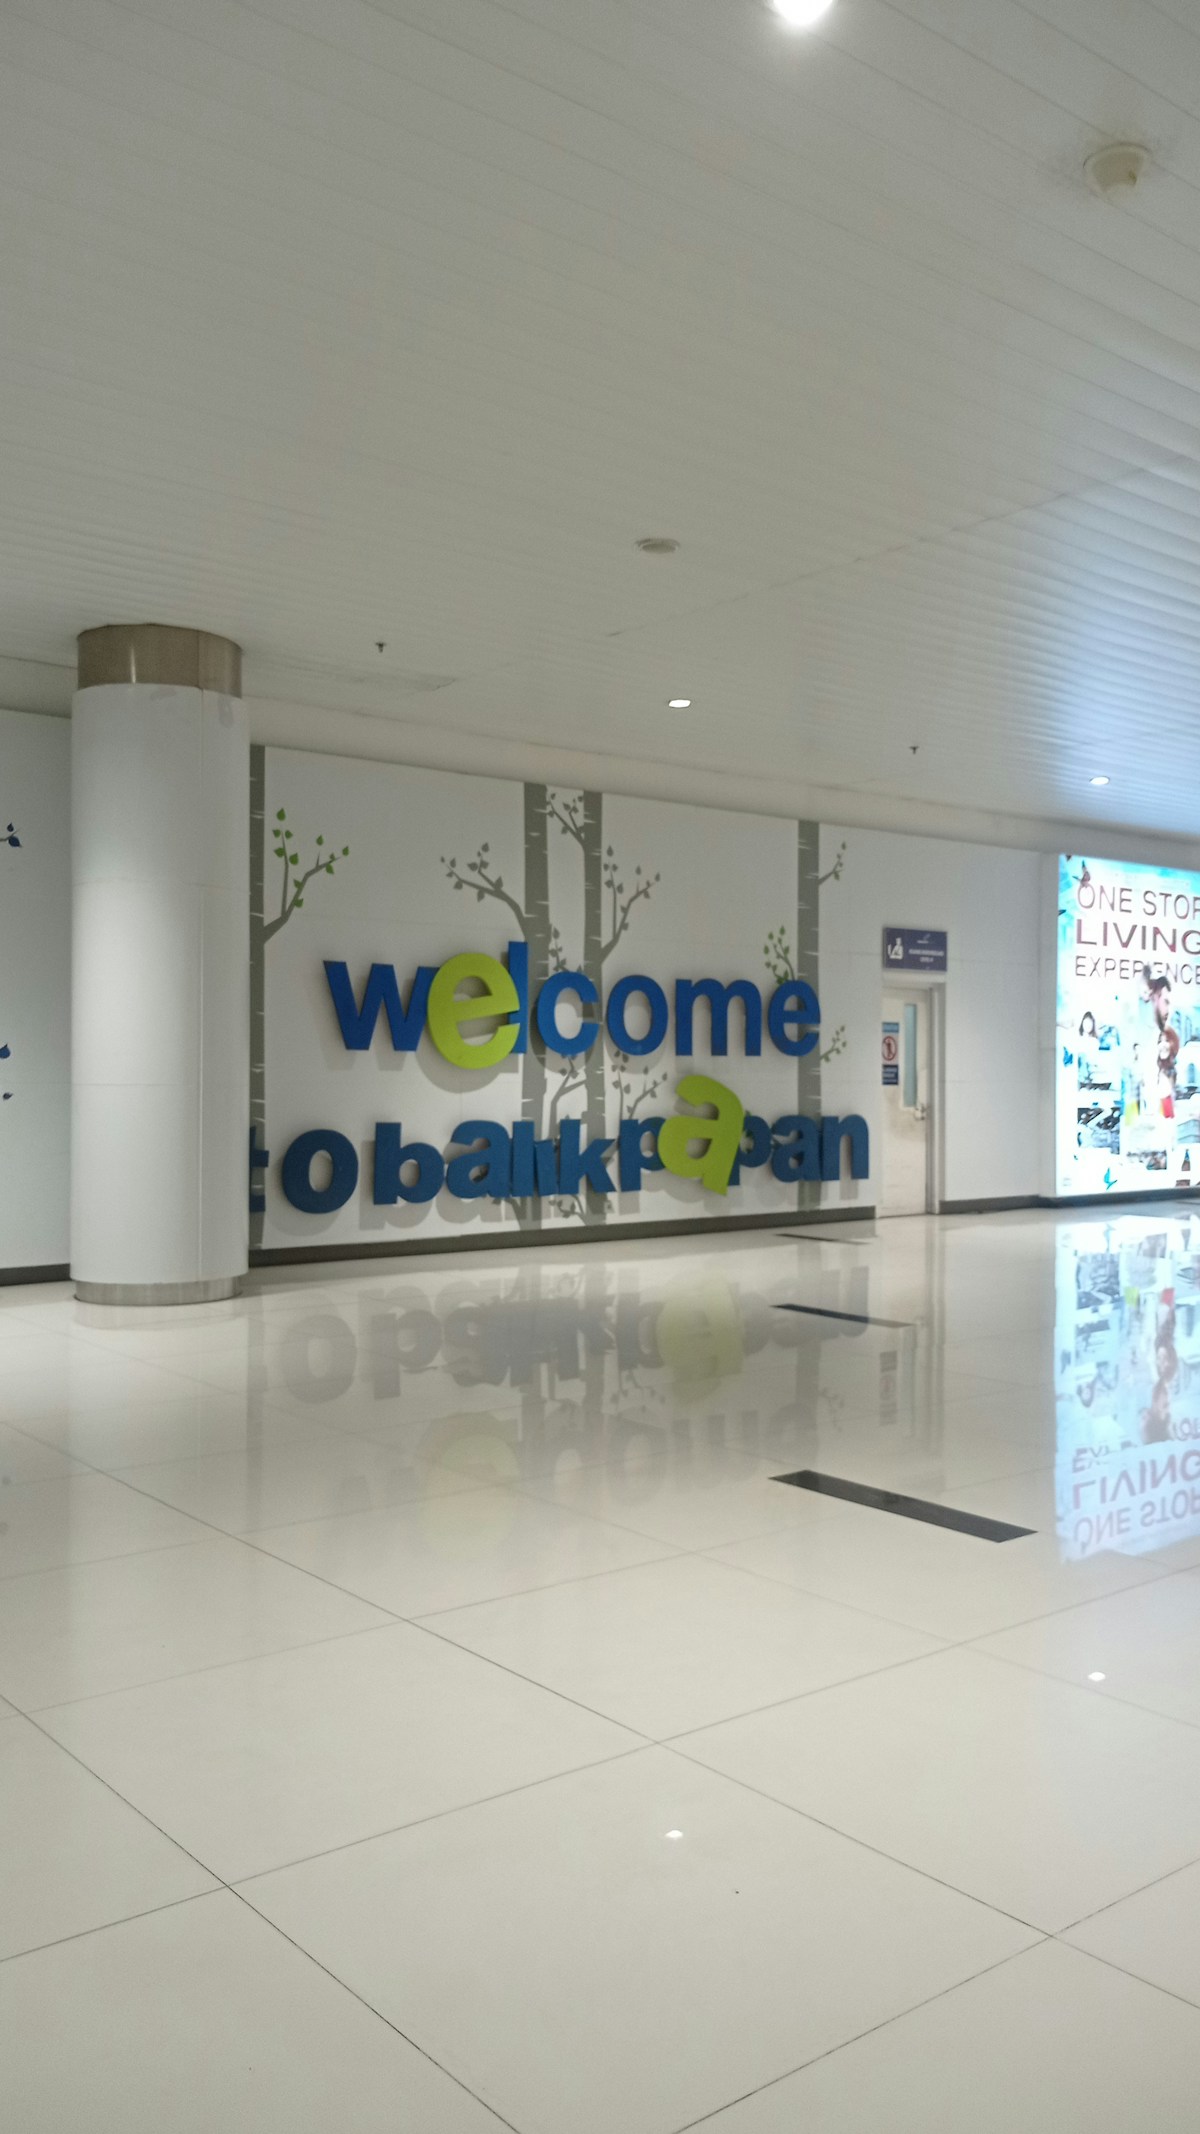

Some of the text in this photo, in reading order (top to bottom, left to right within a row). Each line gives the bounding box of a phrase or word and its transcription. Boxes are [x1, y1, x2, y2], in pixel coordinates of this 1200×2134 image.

[1077, 883, 1133, 914] ONE
[1076, 918, 1200, 955] LIVING
[1075, 955, 1200, 986] EXPERNCE
[322, 941, 821, 1070] welcome
